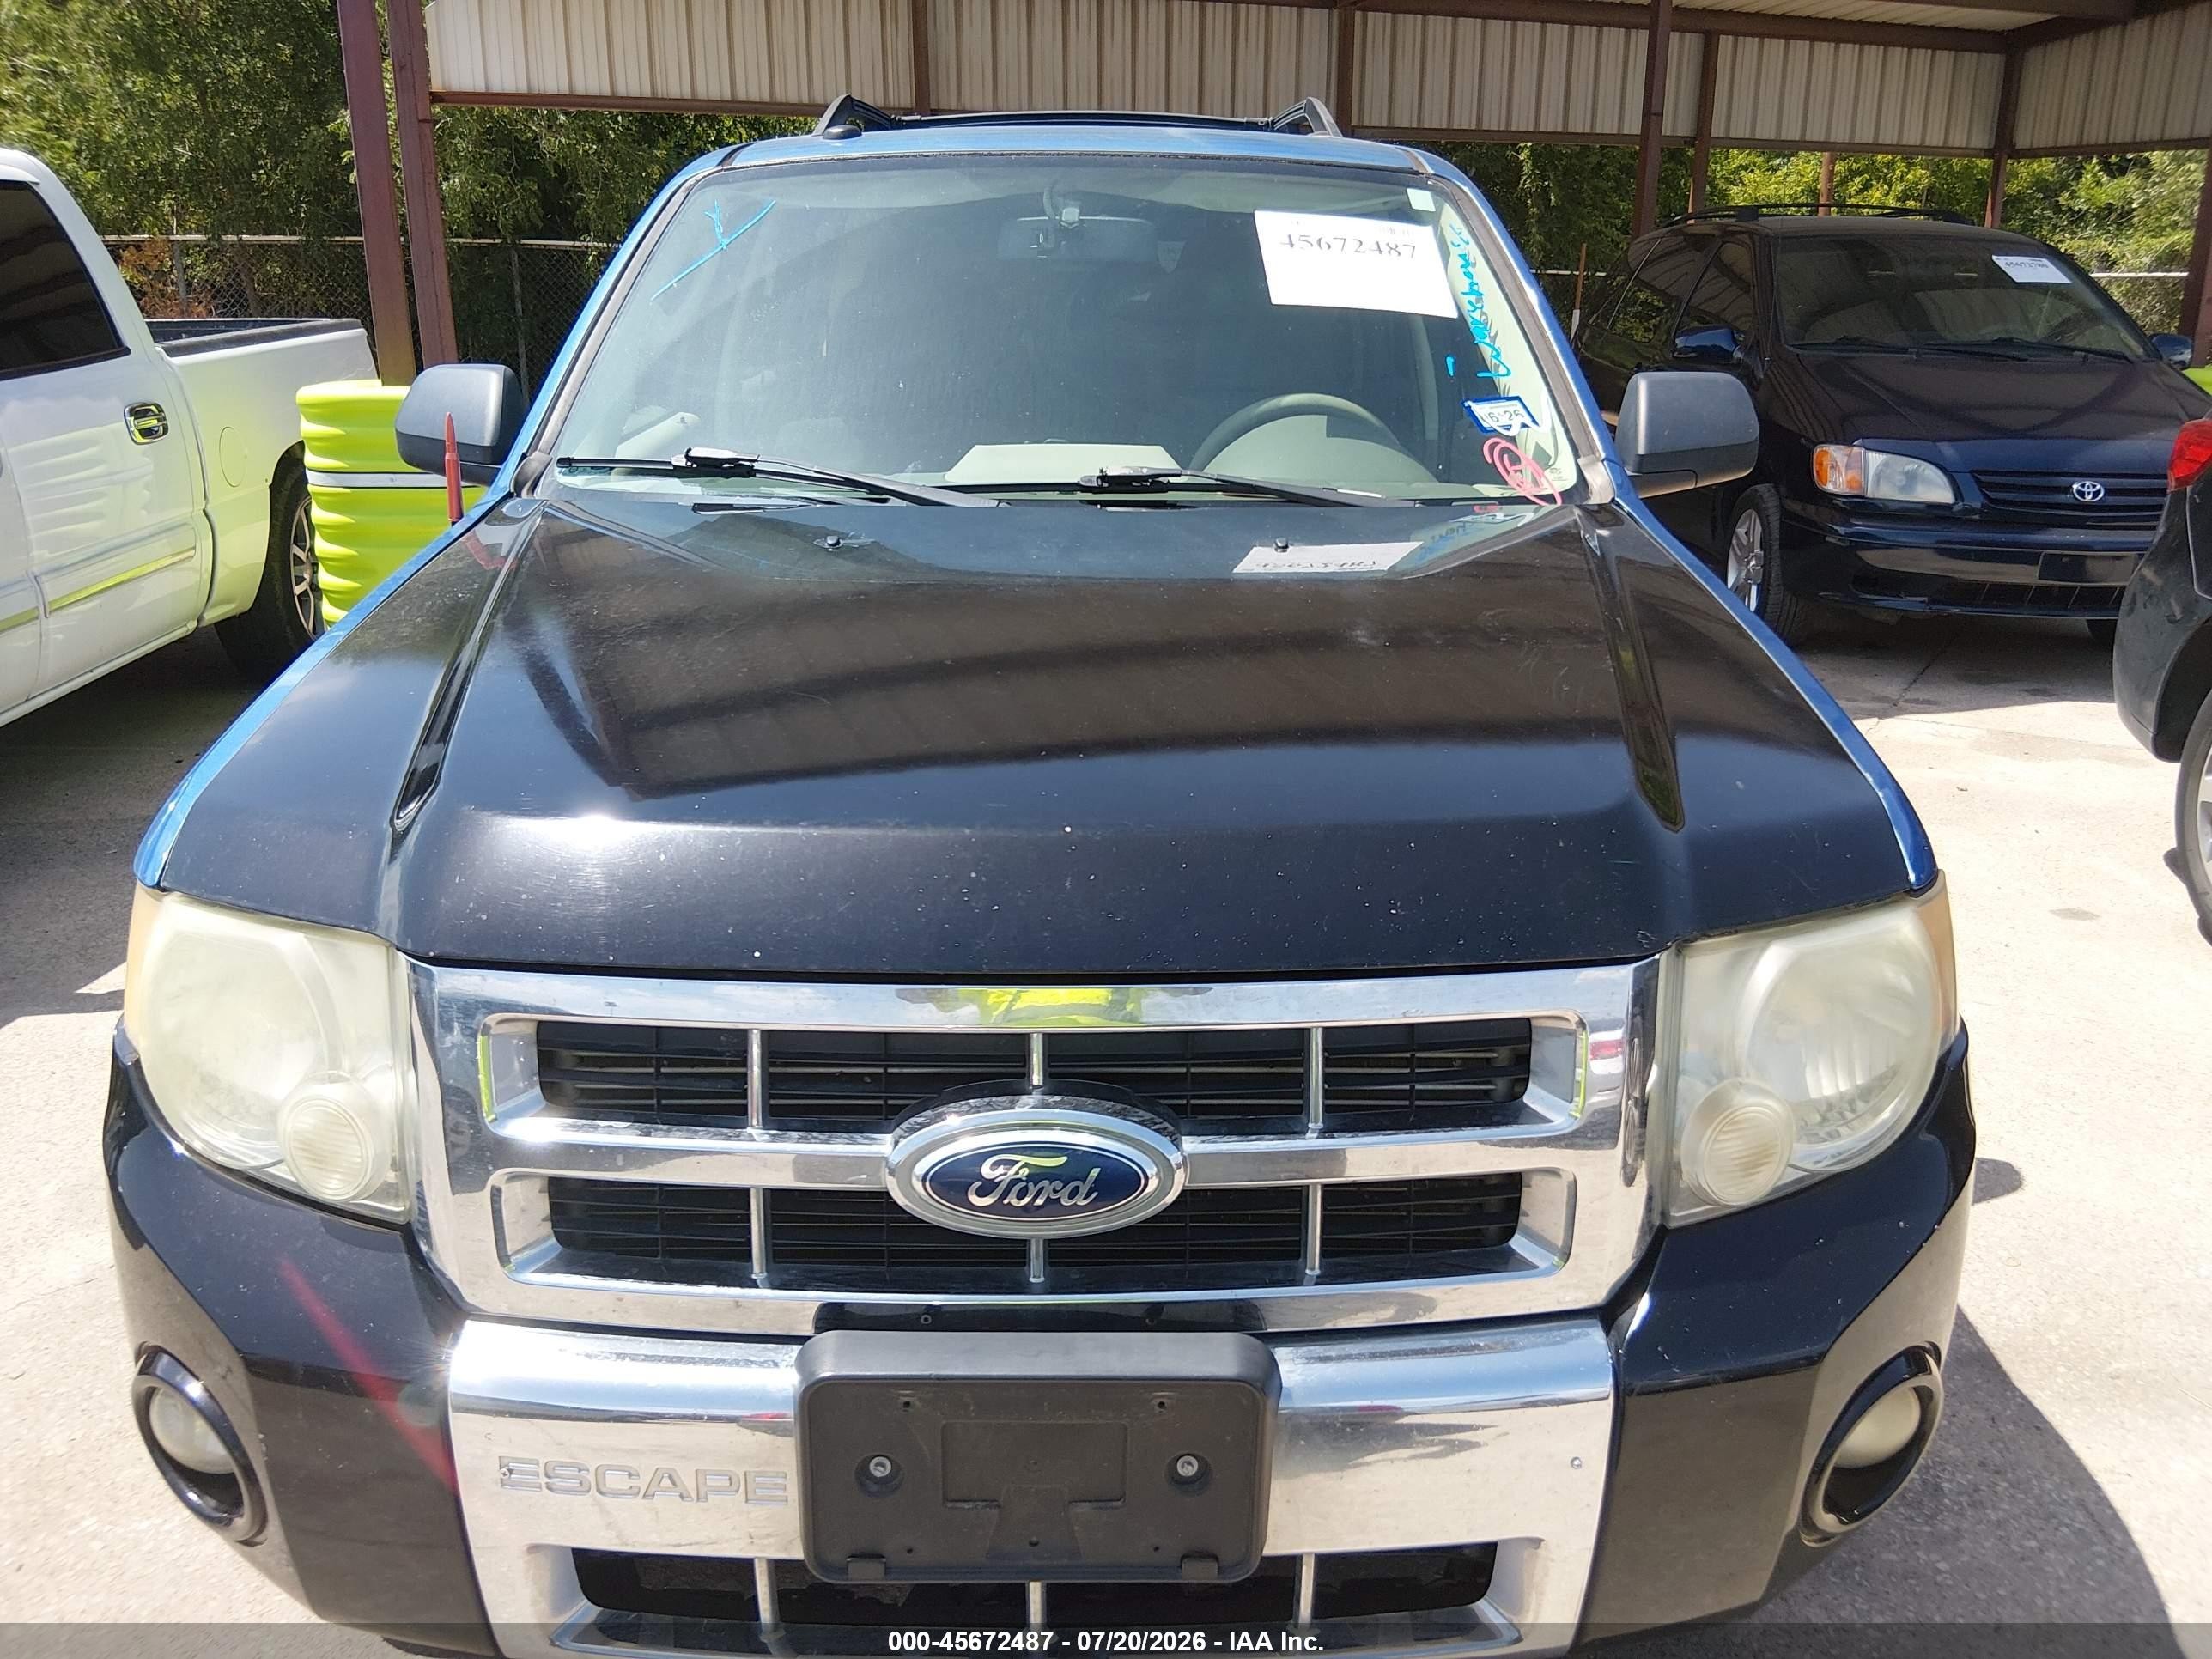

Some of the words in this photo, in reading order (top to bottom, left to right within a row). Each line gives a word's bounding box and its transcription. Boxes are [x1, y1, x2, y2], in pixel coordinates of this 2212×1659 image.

[1279, 233, 1416, 258] 45672487
[967, 1153, 1103, 1207] Ford
[498, 1455, 788, 1505] ESCAPE
